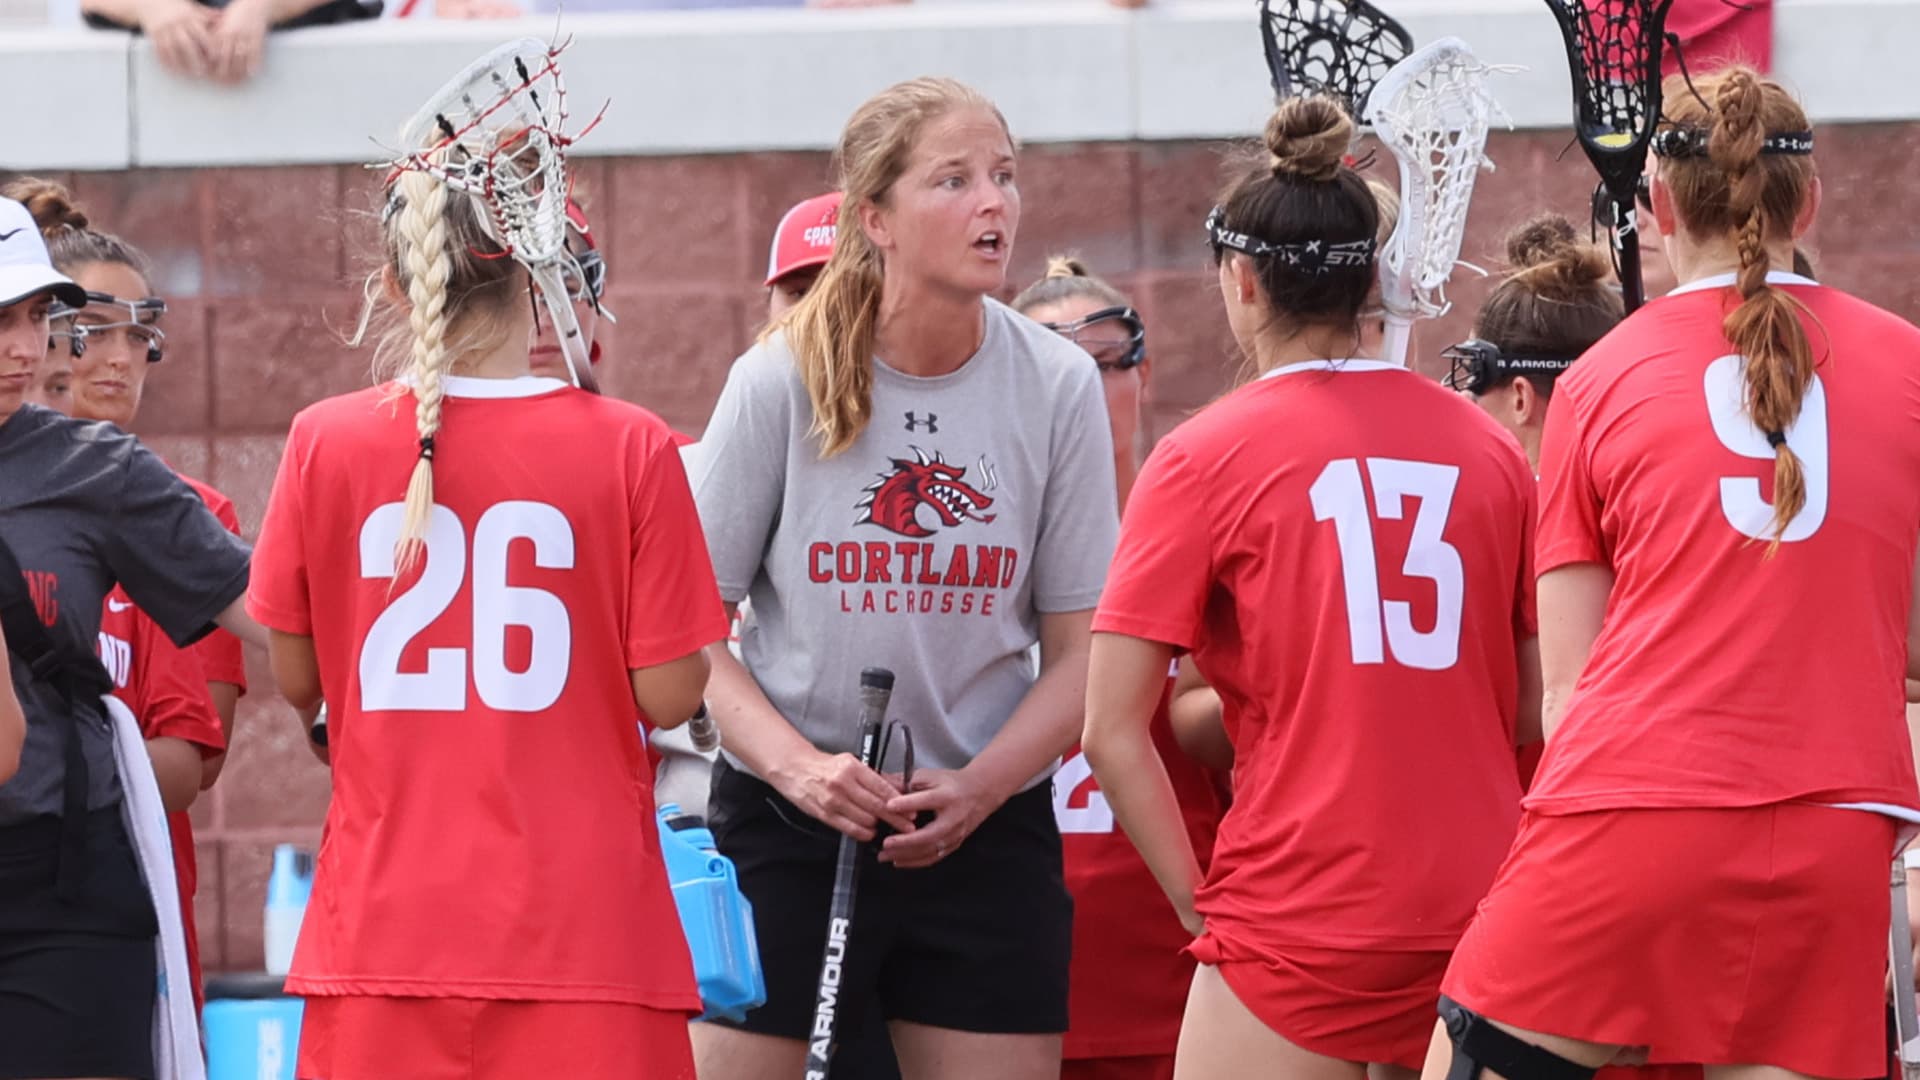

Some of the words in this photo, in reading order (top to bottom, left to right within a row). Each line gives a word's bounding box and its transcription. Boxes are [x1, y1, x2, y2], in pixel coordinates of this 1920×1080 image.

[1324, 250, 1370, 266] STX
[1510, 359, 1573, 369] ARMOU
[1703, 354, 1829, 542] 9
[358, 499, 575, 713] 26
[808, 541, 1018, 589] CORTLAND
[840, 589, 995, 616] LACROSSE
[1308, 456, 1464, 671] 13
[810, 917, 850, 1063] ARMOUR
